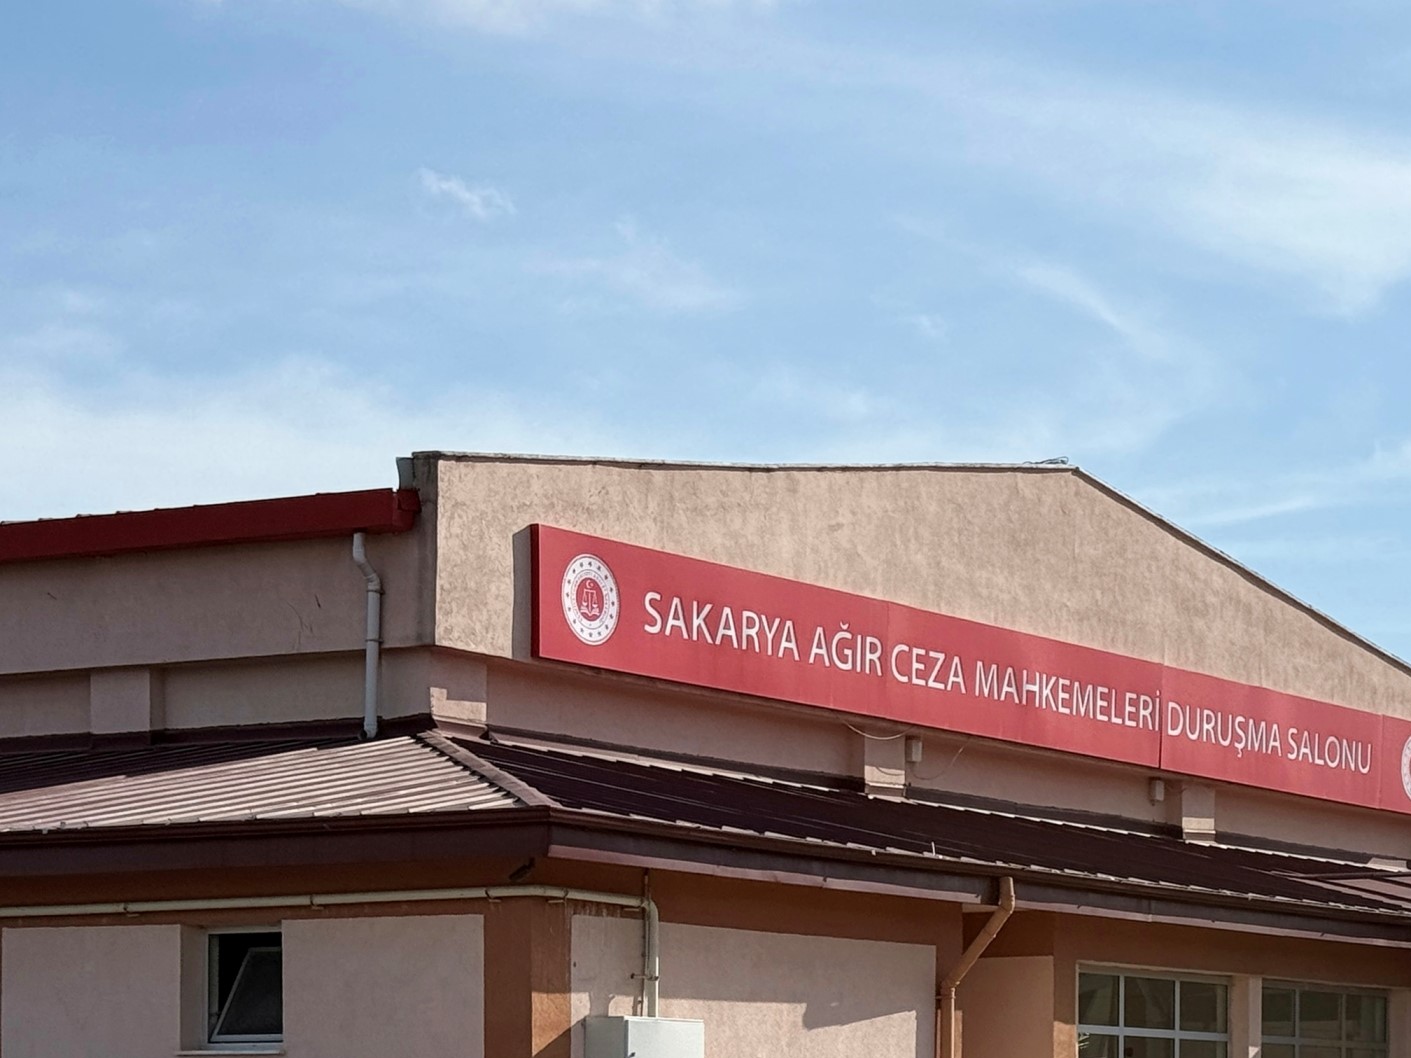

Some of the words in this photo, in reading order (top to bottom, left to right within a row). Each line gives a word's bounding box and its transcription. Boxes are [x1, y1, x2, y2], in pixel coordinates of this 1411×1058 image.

[643, 591, 800, 661] SAKARYA
[808, 622, 882, 677] AĞIR
[890, 643, 967, 694] CEZA
[974, 660, 1161, 732] MAHKEMELERİ
[1167, 701, 1283, 758] DURUŞMA
[1287, 727, 1373, 775] SALONU
